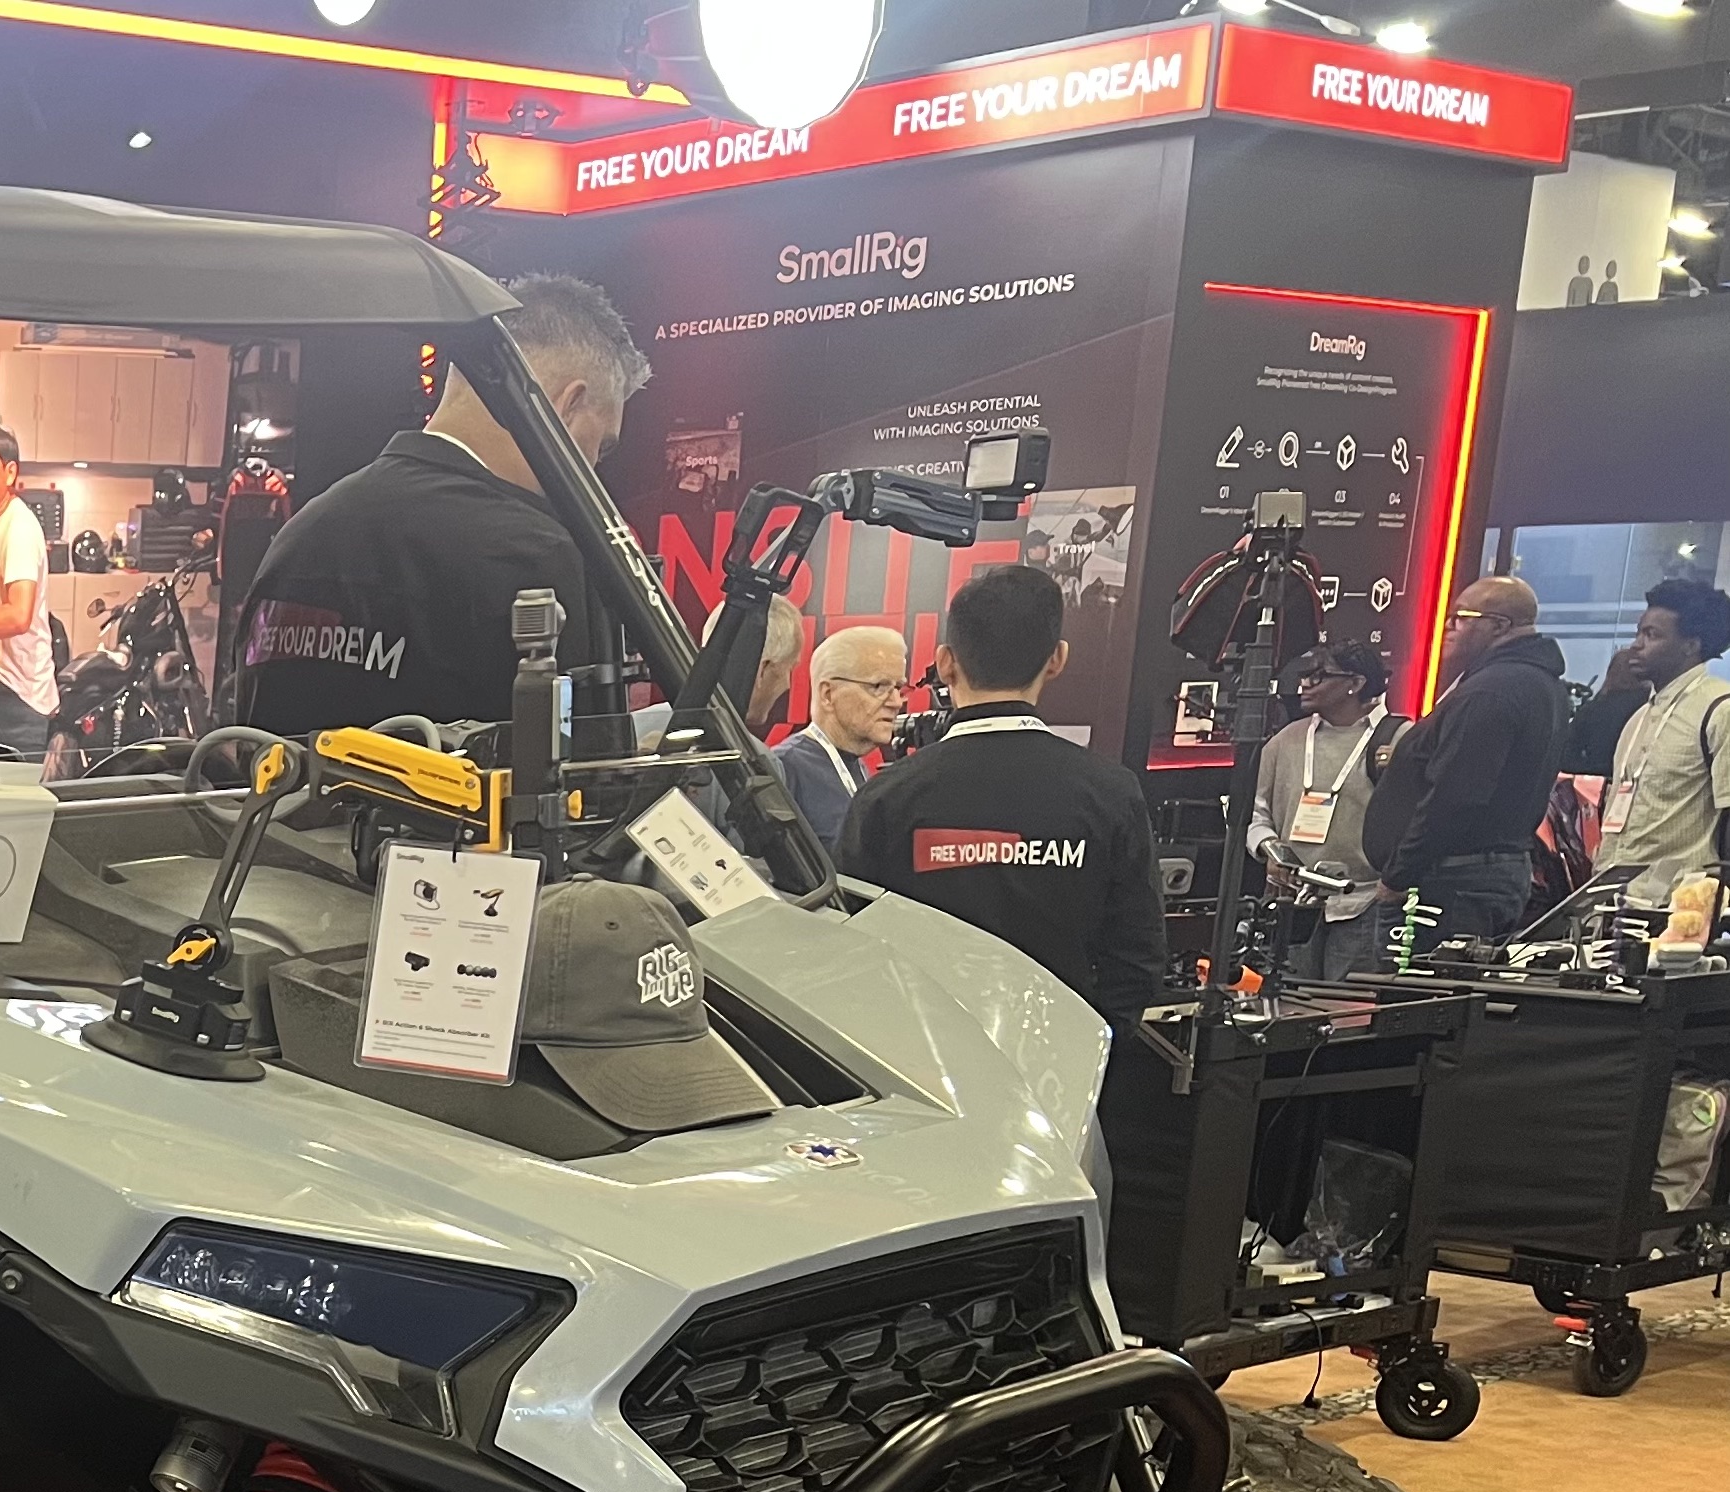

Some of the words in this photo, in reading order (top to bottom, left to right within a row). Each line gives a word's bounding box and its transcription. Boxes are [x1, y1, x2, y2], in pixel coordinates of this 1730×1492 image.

[893, 93, 965, 136] FREE
[971, 76, 1058, 124] YOUR
[1064, 54, 1181, 108] DREAM
[1312, 64, 1364, 102] FREE
[1366, 70, 1421, 113] YOUR
[1423, 83, 1489, 126] DREAM
[576, 153, 635, 191] FREE
[641, 142, 710, 180] YOUR
[715, 127, 809, 168] DREAM
[776, 231, 928, 284] SmallRig
[655, 327, 666, 341] A
[671, 313, 770, 340] SPECIALIZED
[774, 305, 856, 328] PROVIDER
[860, 301, 883, 320] OF
[887, 288, 965, 316] IMAGING
[968, 274, 1076, 304] SOLUTIONS
[1309, 331, 1366, 361] DreamRig
[873, 425, 906, 441] WITH
[908, 420, 963, 438] IMAGING
[966, 414, 1040, 433] SOLUTIONS
[907, 402, 967, 419] UNLEASH
[970, 394, 1042, 413] POTENTIAL
[1058, 540, 1096, 554] Travel
[278, 626, 316, 657] YOUR
[318, 626, 406, 679] DREM
[930, 845, 956, 862] FREE
[958, 843, 998, 863] YOUR
[1001, 840, 1086, 868] DREAM
